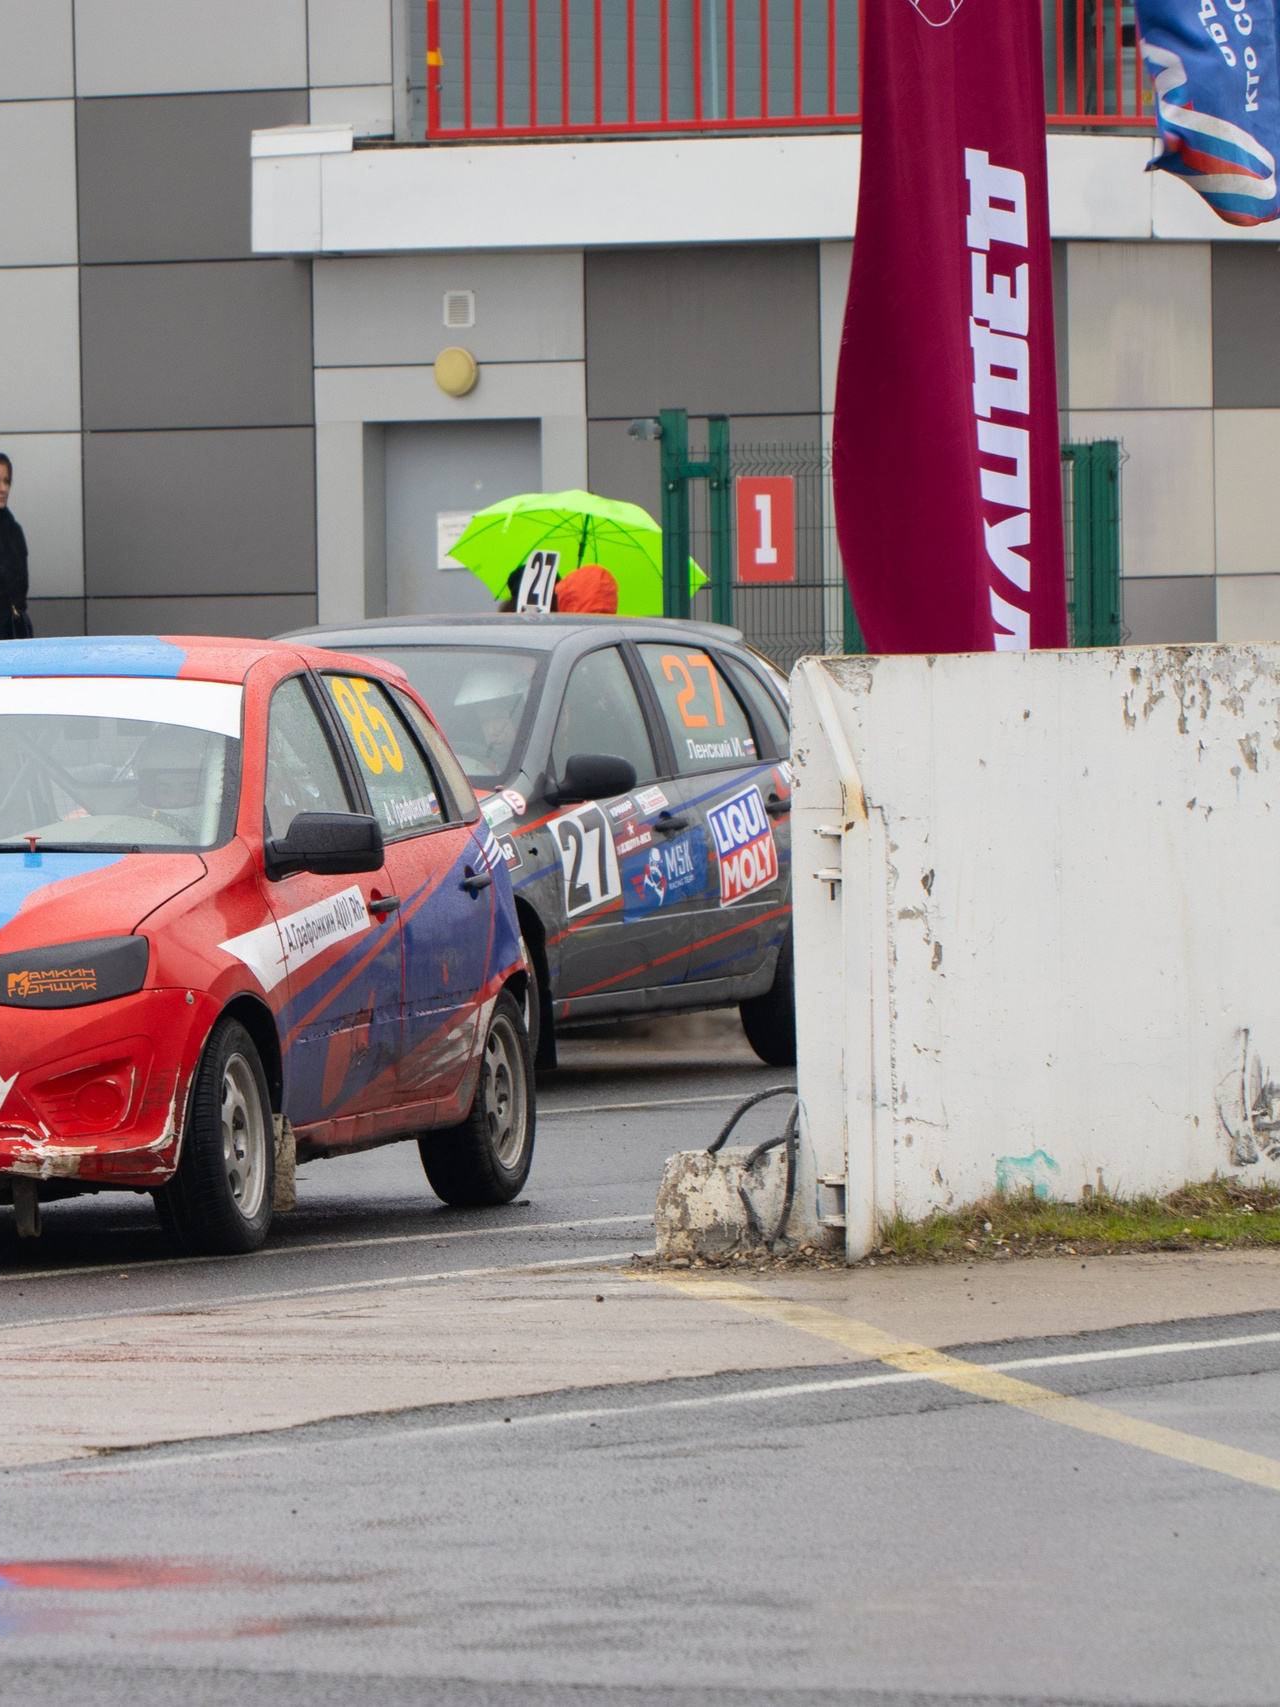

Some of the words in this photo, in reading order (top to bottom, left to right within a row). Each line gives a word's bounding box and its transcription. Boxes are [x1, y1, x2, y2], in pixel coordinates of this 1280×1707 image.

[1244, 46, 1260, 112] КТО
[755, 495, 778, 565] 1
[526, 551, 558, 606] 27
[661, 654, 725, 728] 27
[331, 678, 404, 775] 85
[686, 738, 732, 759] Ленский
[712, 792, 767, 854] LIQUI
[558, 807, 609, 913] 27
[665, 840, 695, 881] MSK
[722, 836, 771, 899] MOLY
[7, 968, 96, 989] МАМКИН
[7, 981, 98, 998] ГОНЩИК
